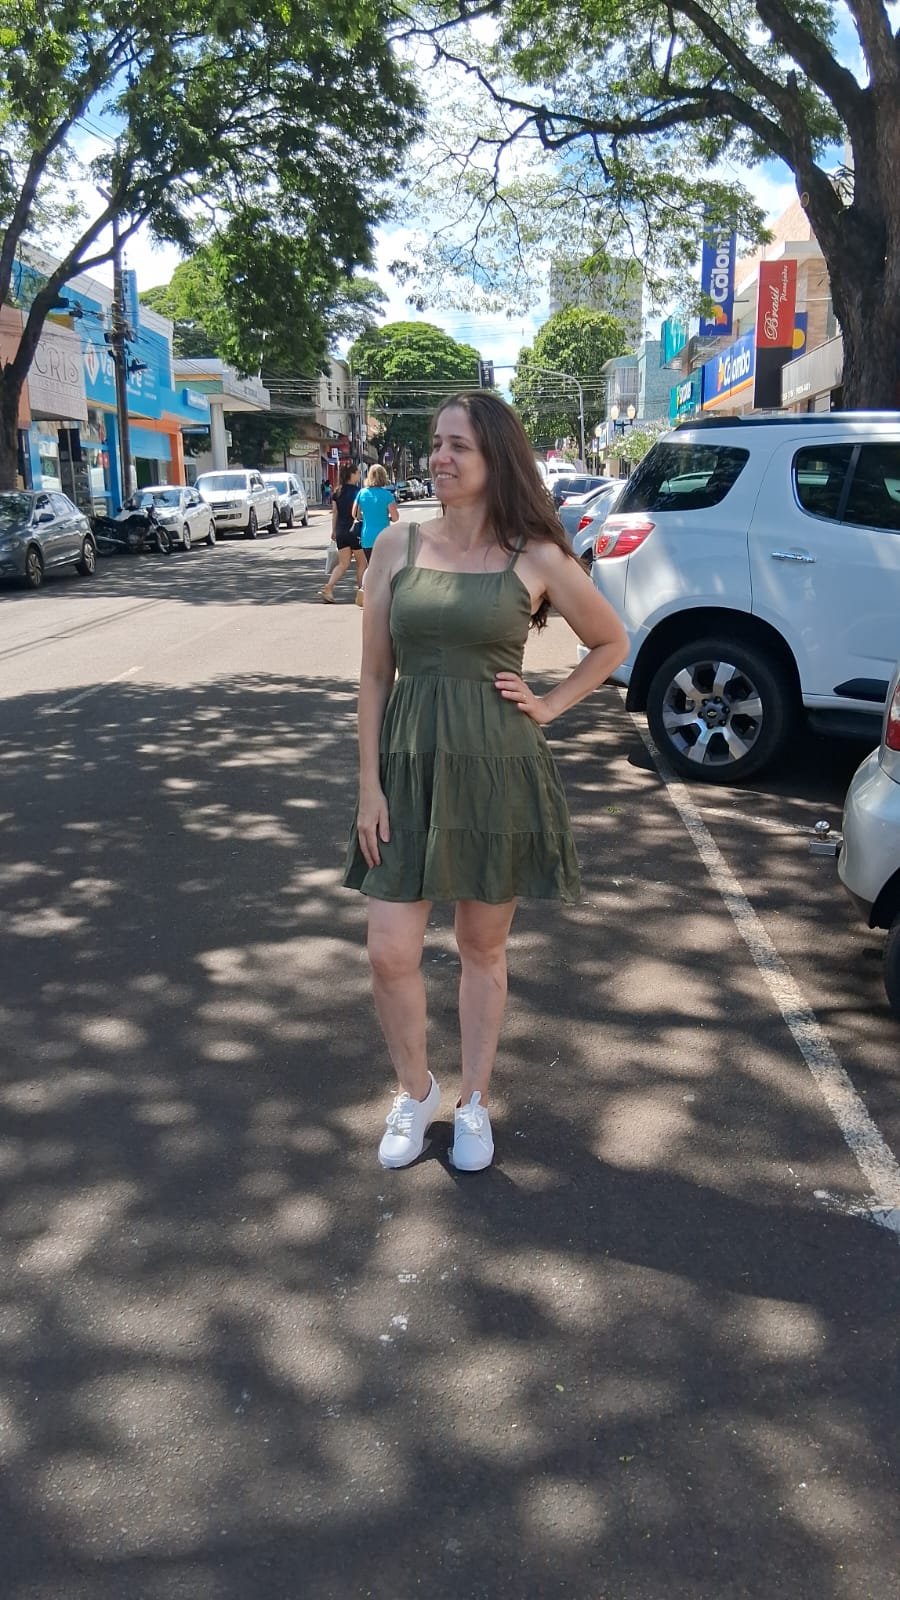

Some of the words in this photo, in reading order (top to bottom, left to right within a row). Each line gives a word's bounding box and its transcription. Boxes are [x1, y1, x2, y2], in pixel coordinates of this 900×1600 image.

[710, 216, 731, 303] Colom
[764, 285, 780, 341] Brasil
[34, 341, 80, 384] CRIS
